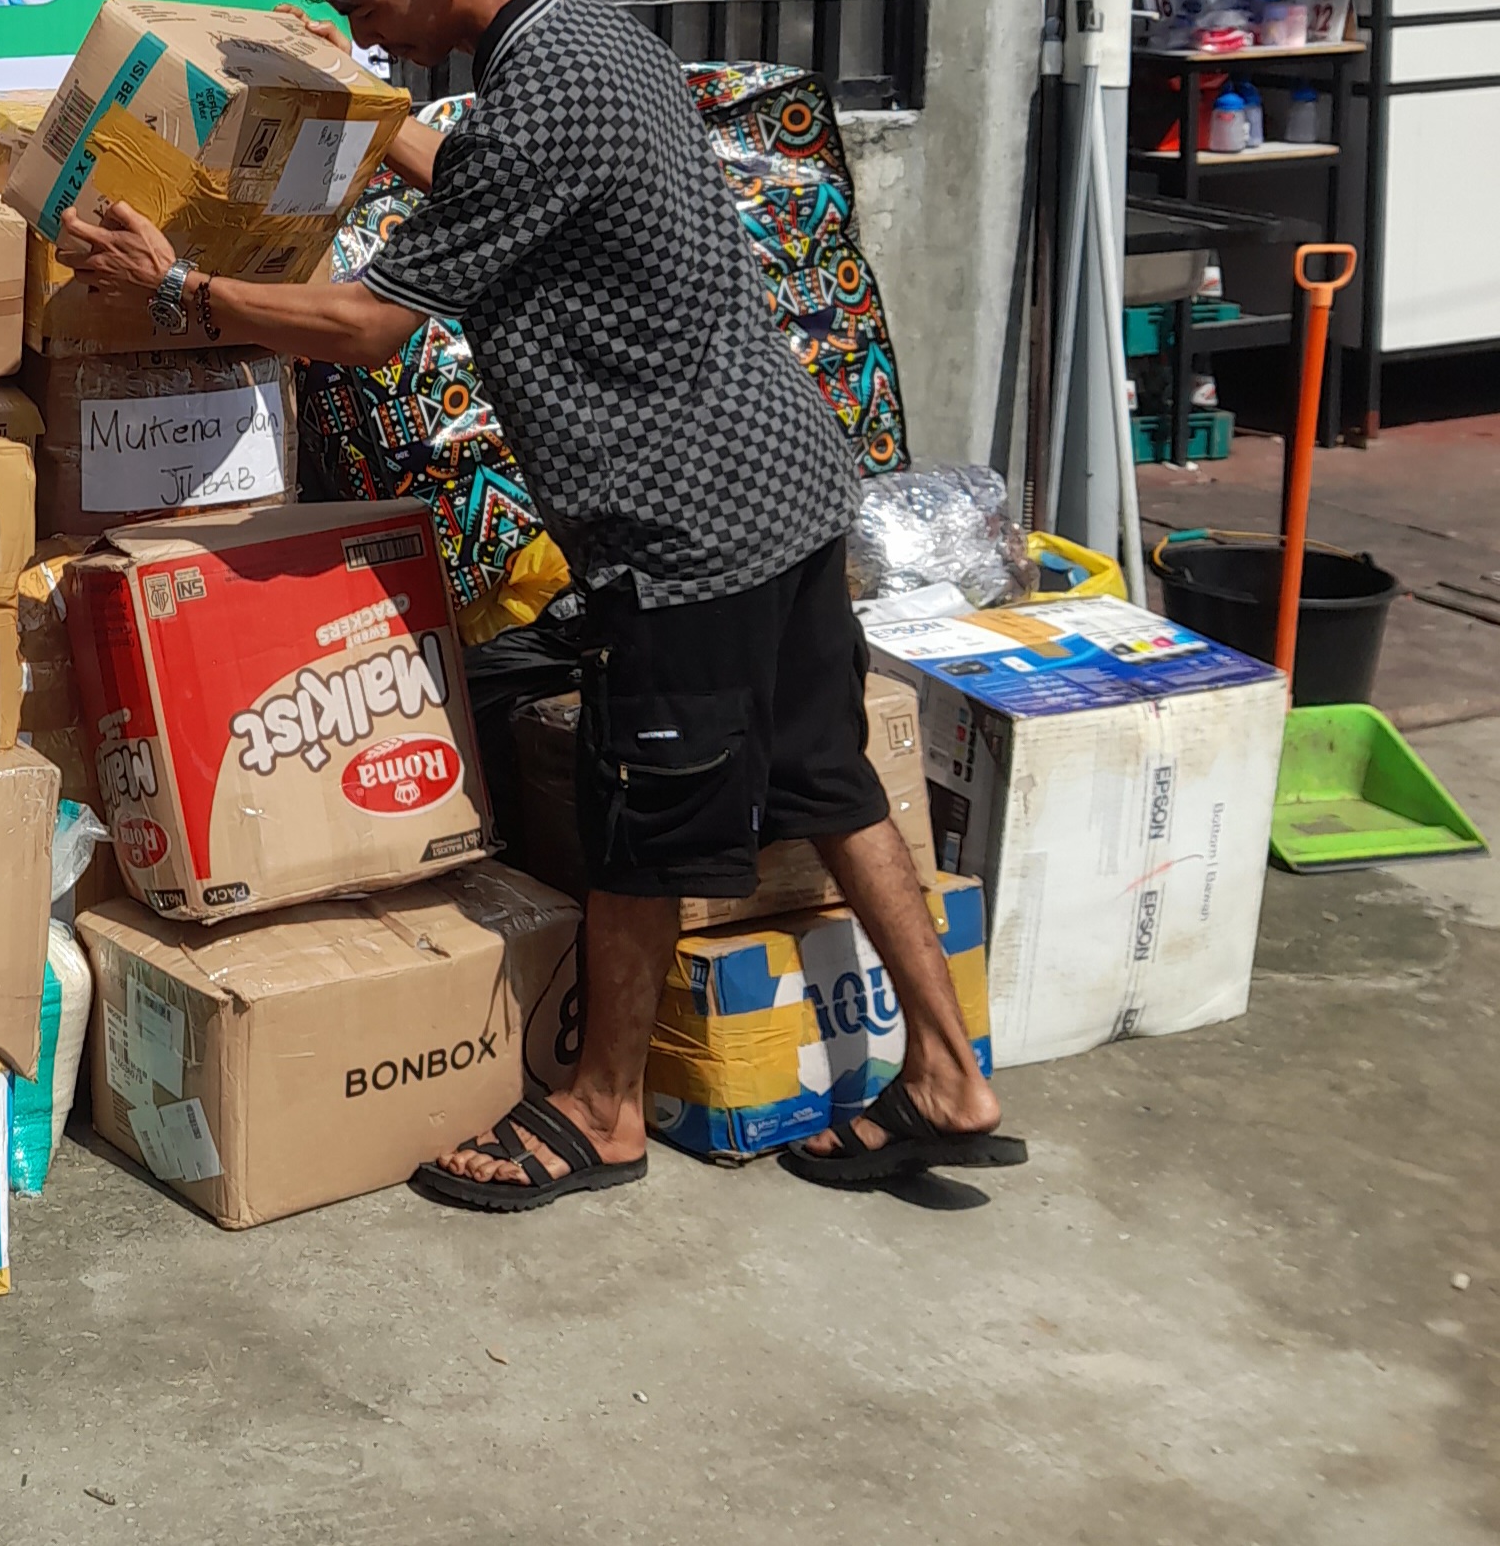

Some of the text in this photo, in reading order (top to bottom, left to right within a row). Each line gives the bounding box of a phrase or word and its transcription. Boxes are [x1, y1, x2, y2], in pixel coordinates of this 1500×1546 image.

[127, 59, 148, 82] ISI
[68, 175, 82, 190] 2
[51, 189, 76, 225] liter
[236, 405, 279, 435] dan
[160, 464, 256, 506] JILBAB
[177, 579, 205, 600] SNI
[315, 593, 410, 647] CRACKERS
[867, 621, 948, 641] EPSON
[230, 632, 449, 776] Malkist
[356, 748, 448, 788] Roma
[1148, 765, 1172, 841] EPSON
[208, 883, 247, 903] PACK
[1133, 889, 1158, 962] EPSON
[345, 1031, 498, 1099] BONBOX
